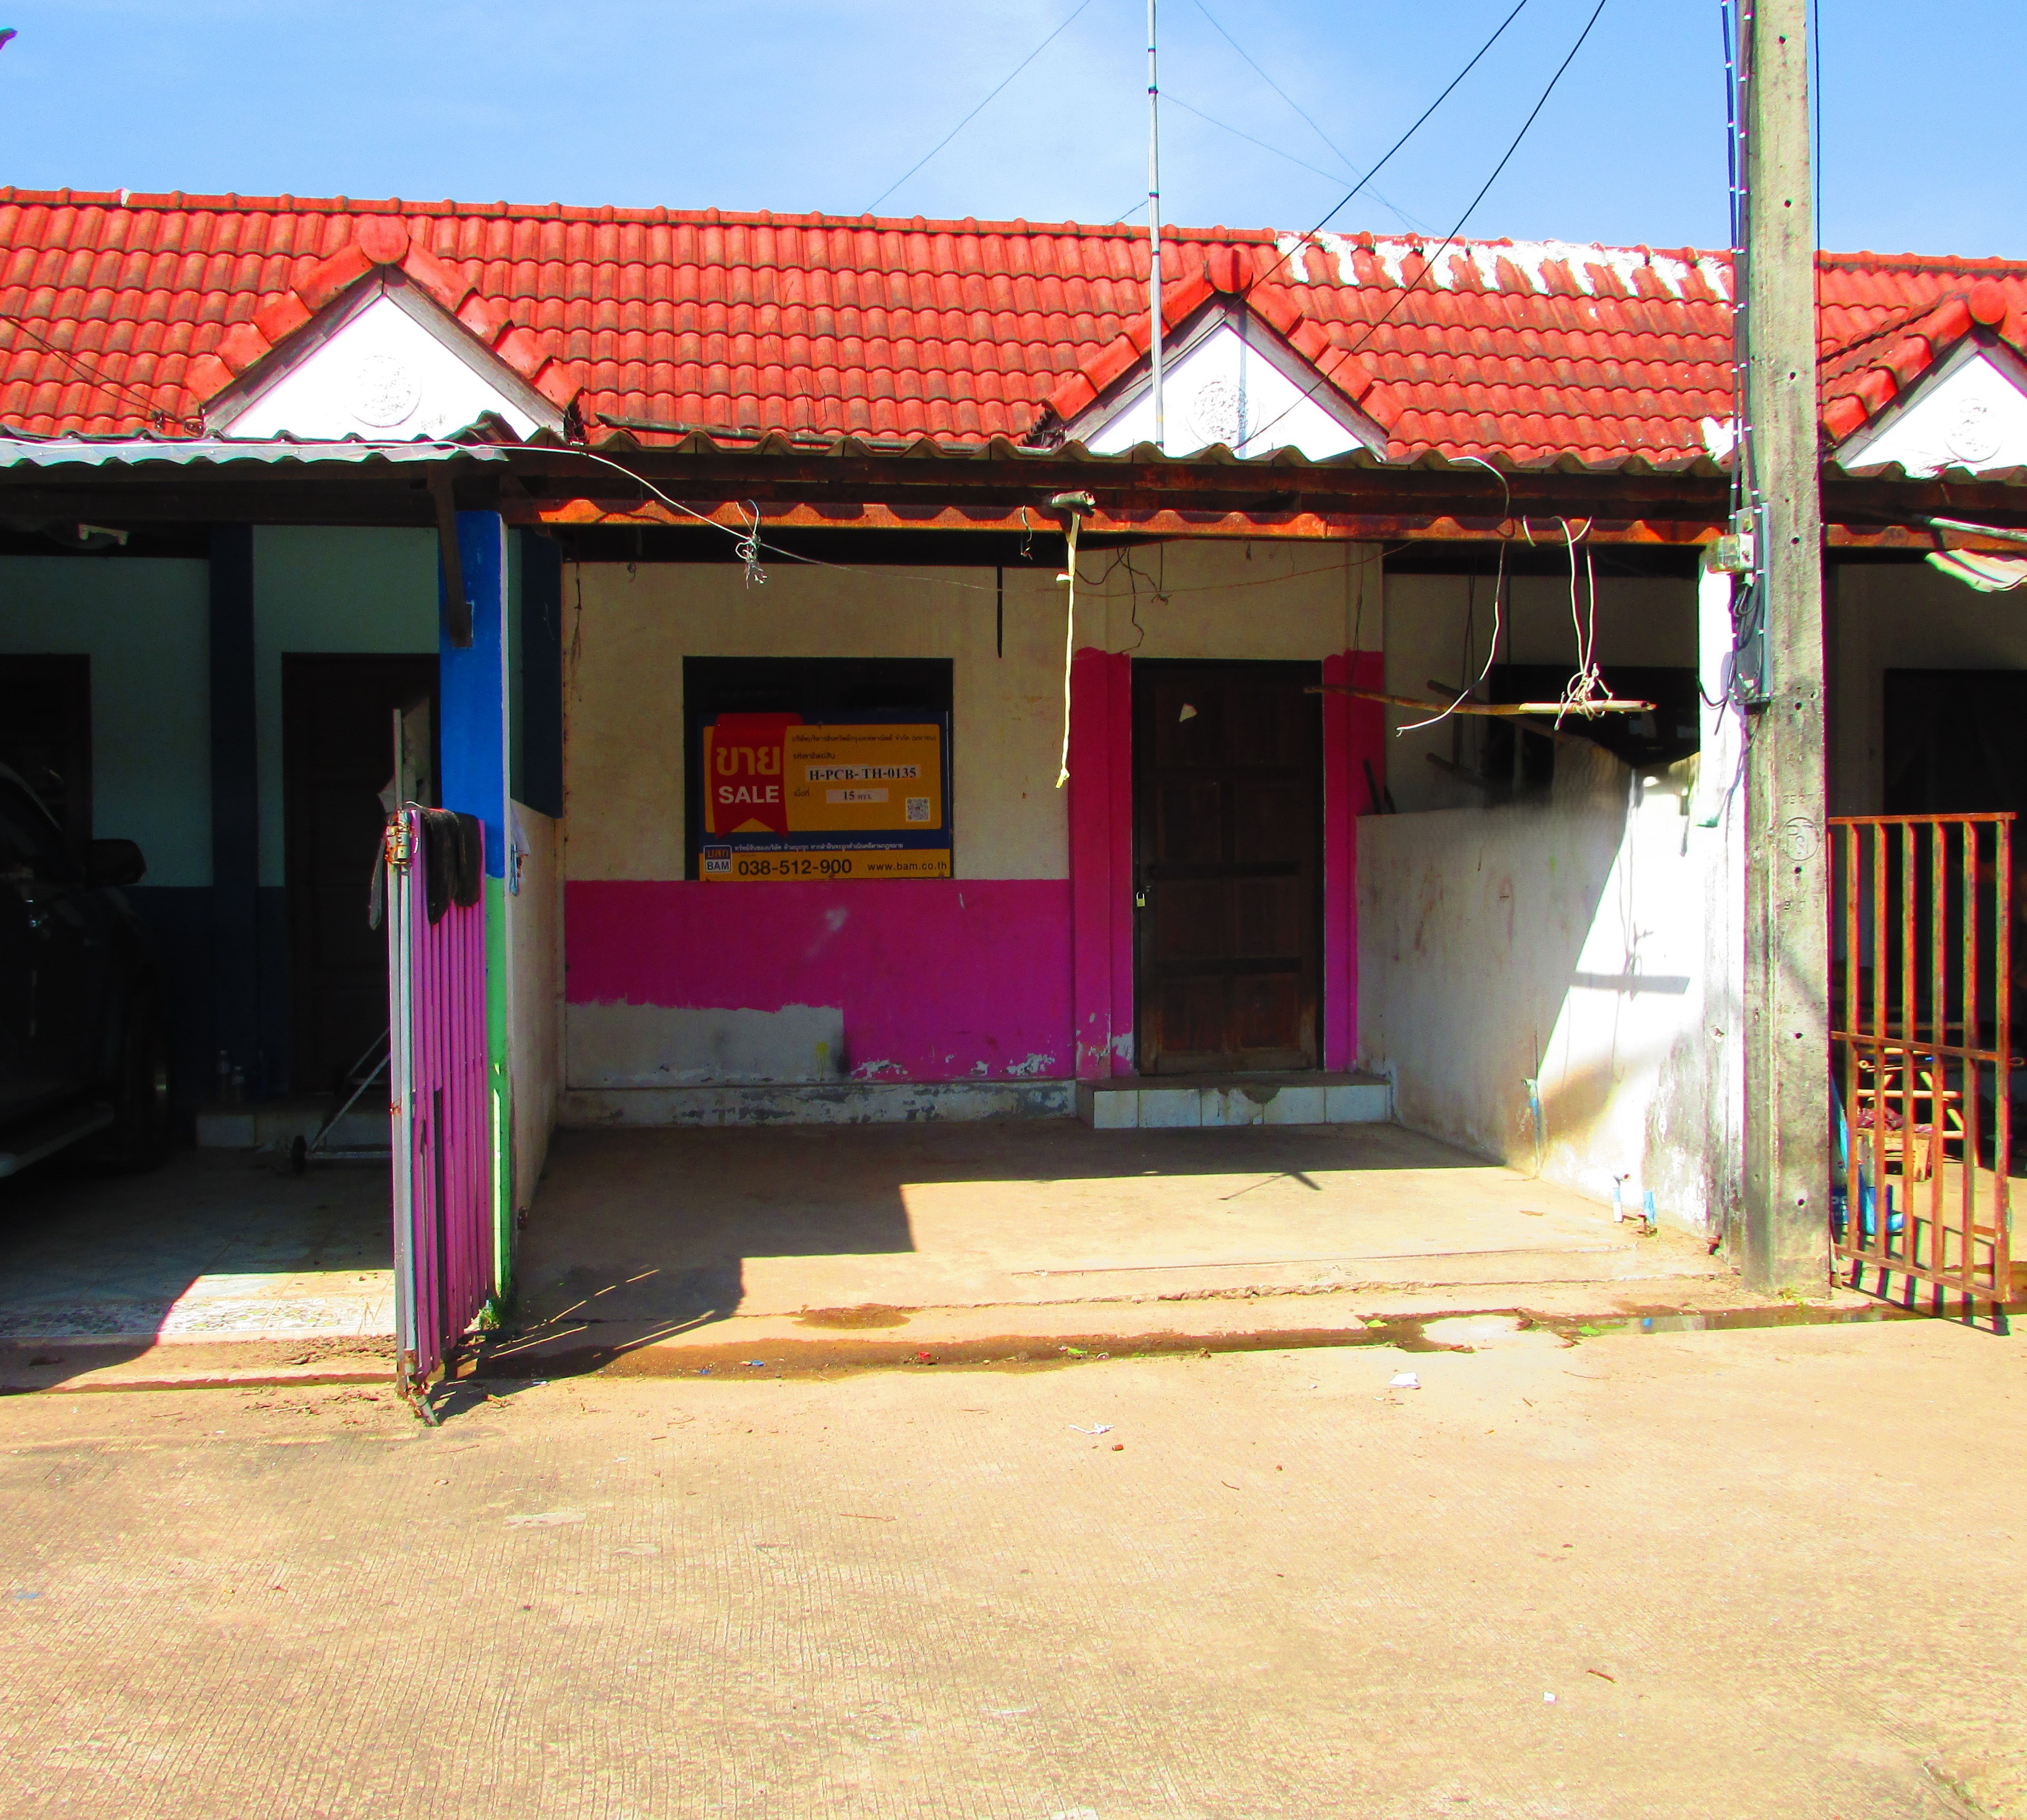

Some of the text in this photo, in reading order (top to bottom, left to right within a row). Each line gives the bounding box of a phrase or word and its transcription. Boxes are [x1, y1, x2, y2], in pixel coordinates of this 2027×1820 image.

[716, 746, 780, 776] ขาย
[718, 785, 779, 804] SALE
[844, 791, 855, 800] 15
[707, 861, 729, 871] BAM
[738, 859, 853, 875] 038-512-900
[867, 861, 947, 871] www.bam.co.th
